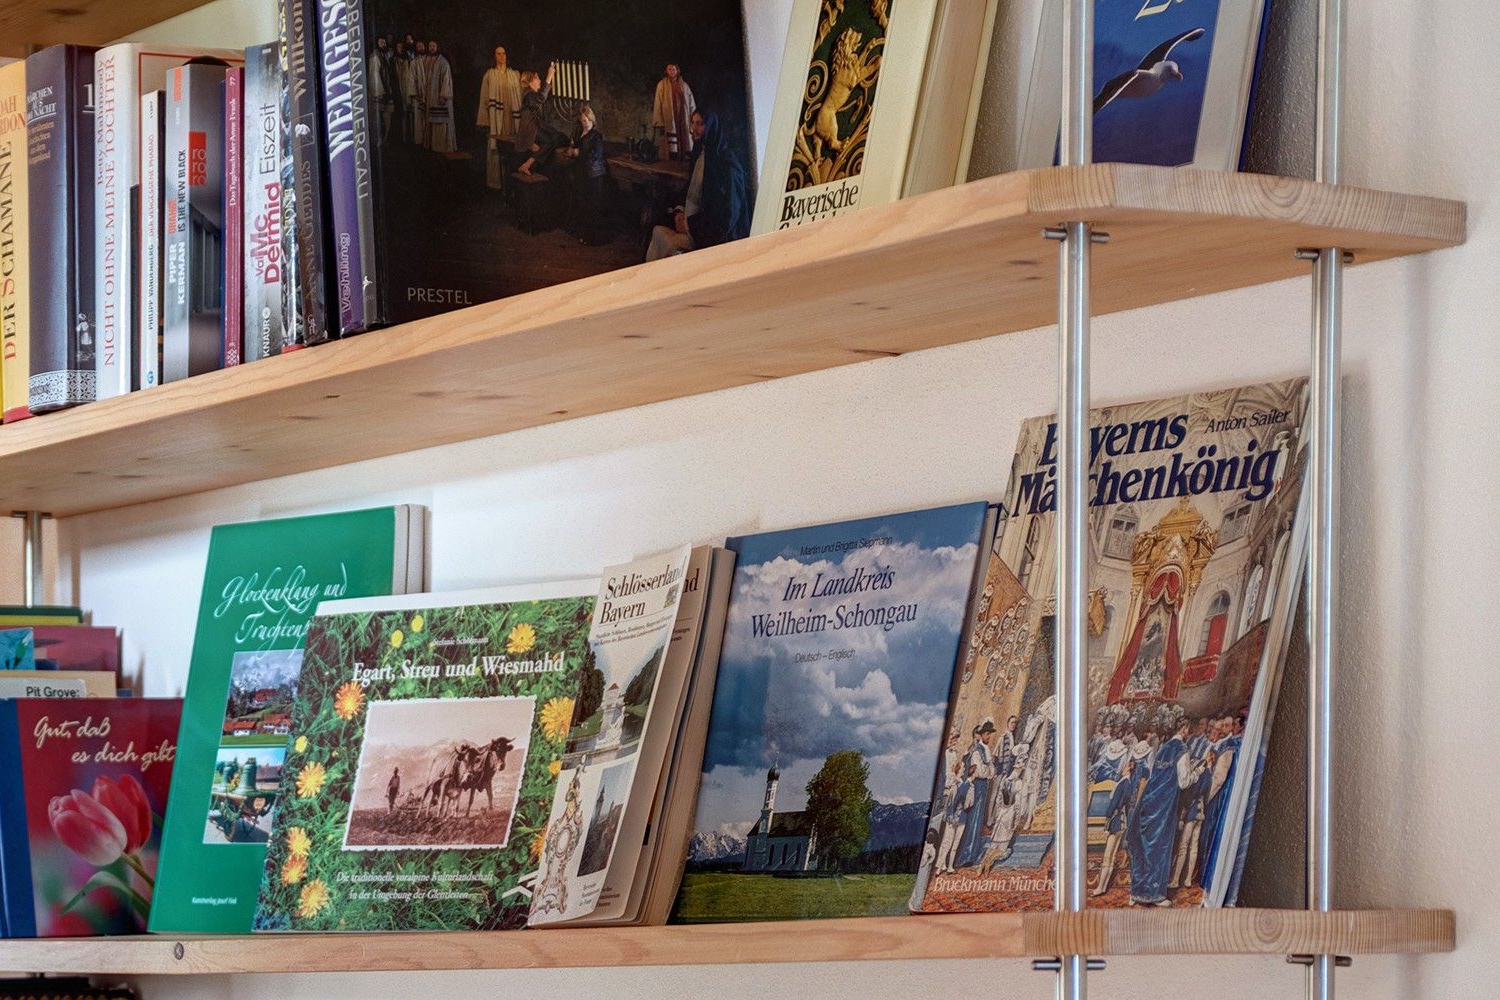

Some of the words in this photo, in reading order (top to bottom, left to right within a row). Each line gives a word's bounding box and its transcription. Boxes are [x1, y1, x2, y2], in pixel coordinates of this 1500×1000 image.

[104, 55, 116, 154] TOCHTER
[259, 103, 276, 175] Eiszeit
[97, 148, 108, 186] Betty
[177, 150, 187, 180] BLACK
[229, 149, 237, 191] Tagebuch
[104, 159, 116, 230] MEINE
[177, 181, 187, 203] NEW
[229, 192, 237, 207] Das
[780, 180, 860, 223] Bayerische
[177, 203, 186, 222] THE
[177, 222, 186, 233] IS
[250, 213, 269, 259] Mc
[264, 181, 281, 285] Dermid
[104, 234, 116, 296] OHNE
[168, 242, 178, 284] PIPER
[177, 241, 187, 305] KERMAN
[254, 257, 266, 277] Val
[406, 287, 473, 305] PRESTEL
[3, 302, 16, 360] DER
[104, 303, 116, 367] NICHT
[262, 316, 271, 357] KNAUR
[1204, 416, 1248, 434] Anton
[1249, 408, 1292, 428] Sailer
[822, 544, 836, 554] und
[213, 564, 320, 618] Glockenklang
[322, 561, 348, 597] und
[604, 555, 688, 601] Schlösserland
[782, 576, 808, 602] Im
[809, 564, 896, 599] Landkreis
[598, 600, 647, 628] Bayern
[751, 602, 919, 639] Weilheim-Schongau
[351, 662, 397, 688] Egart,
[400, 658, 441, 680] Streu
[444, 656, 478, 678] und
[481, 650, 566, 677] Wiesmahd
[794, 652, 822, 664] Deutsch
[828, 648, 856, 661] Englisch
[26, 686, 41, 698] Pit
[43, 686, 81, 698] Grove:
[33, 715, 80, 749] Gut,
[76, 716, 112, 739] daß
[71, 750, 91, 763] es
[94, 741, 139, 763] dich
[140, 738, 178, 772] gibt
[336, 871, 349, 882] Die
[358, 888, 371, 899] der
[412, 888, 426, 899] der
[933, 875, 1007, 893] Bruckmann
